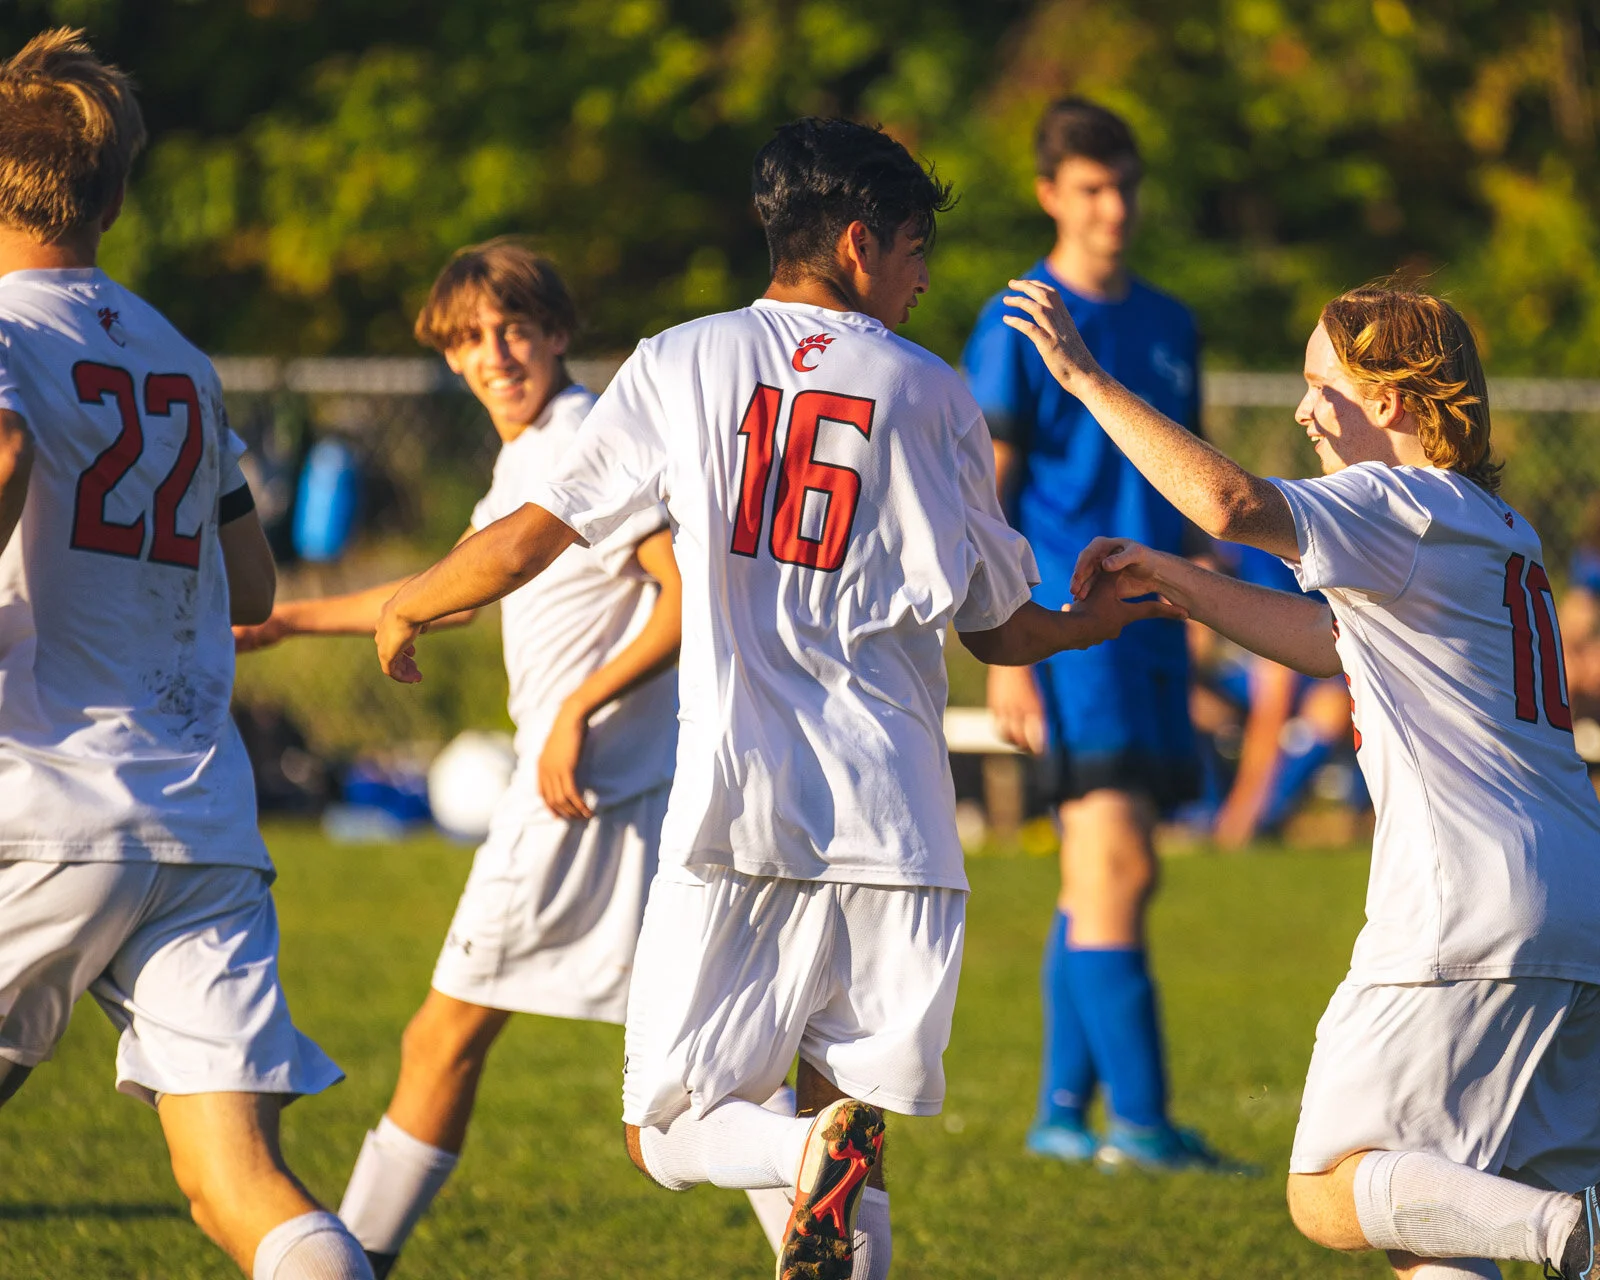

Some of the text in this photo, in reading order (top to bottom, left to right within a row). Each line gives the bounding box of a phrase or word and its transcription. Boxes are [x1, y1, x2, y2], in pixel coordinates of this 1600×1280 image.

[792, 344, 827, 373] C
[70, 360, 204, 572] 22
[730, 382, 876, 573] 16
